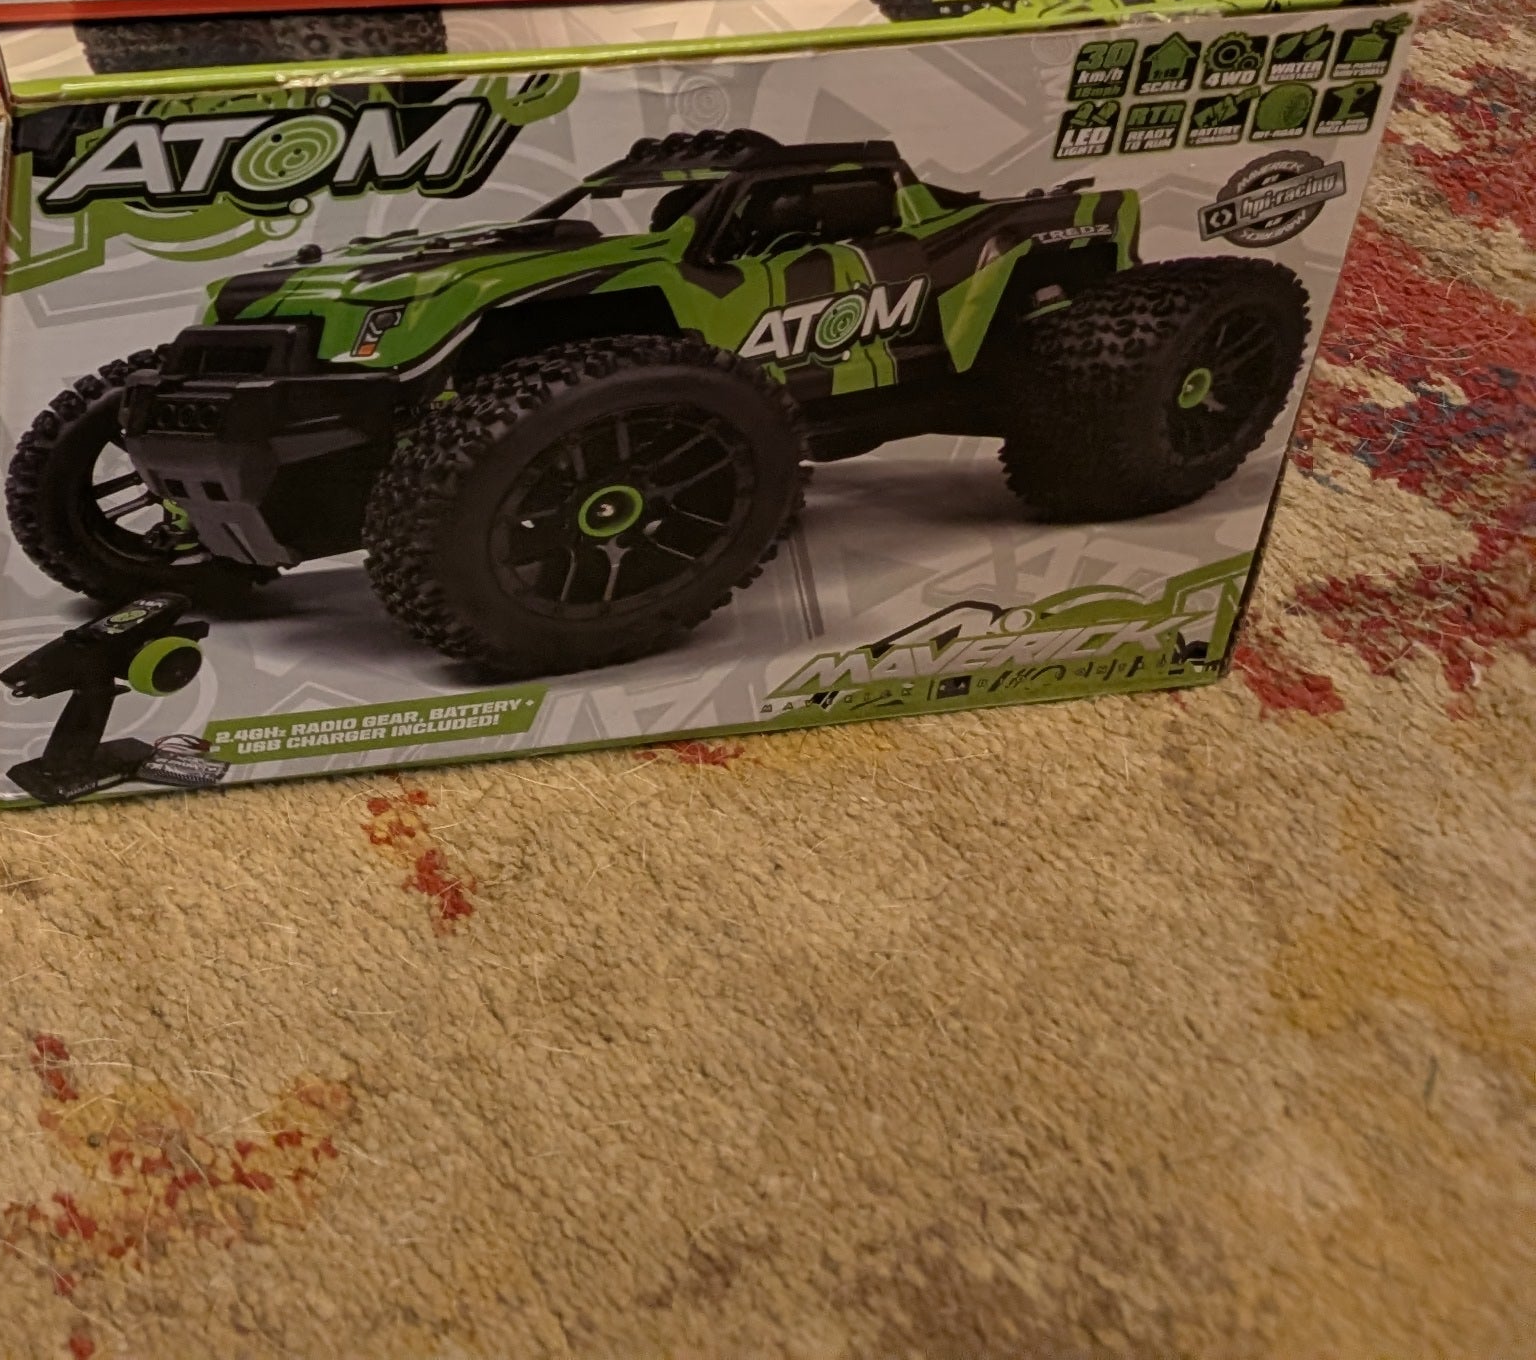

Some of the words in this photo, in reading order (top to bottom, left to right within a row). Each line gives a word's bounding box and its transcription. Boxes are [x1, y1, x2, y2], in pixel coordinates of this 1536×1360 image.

[1077, 41, 1137, 71] 30
[1077, 68, 1125, 84] km/h
[1270, 60, 1325, 75] WATER
[1139, 79, 1188, 94] SCALE
[1205, 69, 1256, 87] 4WD
[1127, 105, 1185, 125] RTR
[1060, 127, 1112, 147] LED
[1126, 127, 1175, 141] READY
[46, 103, 486, 201] ATOM
[1124, 140, 1142, 152] TO
[1144, 138, 1172, 150] RUN
[738, 278, 924, 359] ATOM
[784, 616, 1195, 693] MAVERICK
[291, 717, 357, 736] RADIO
[428, 698, 523, 720] BATTERY
[237, 737, 281, 755] USB
[286, 726, 387, 749] CHARGER
[391, 713, 500, 737] INCLUDED!
